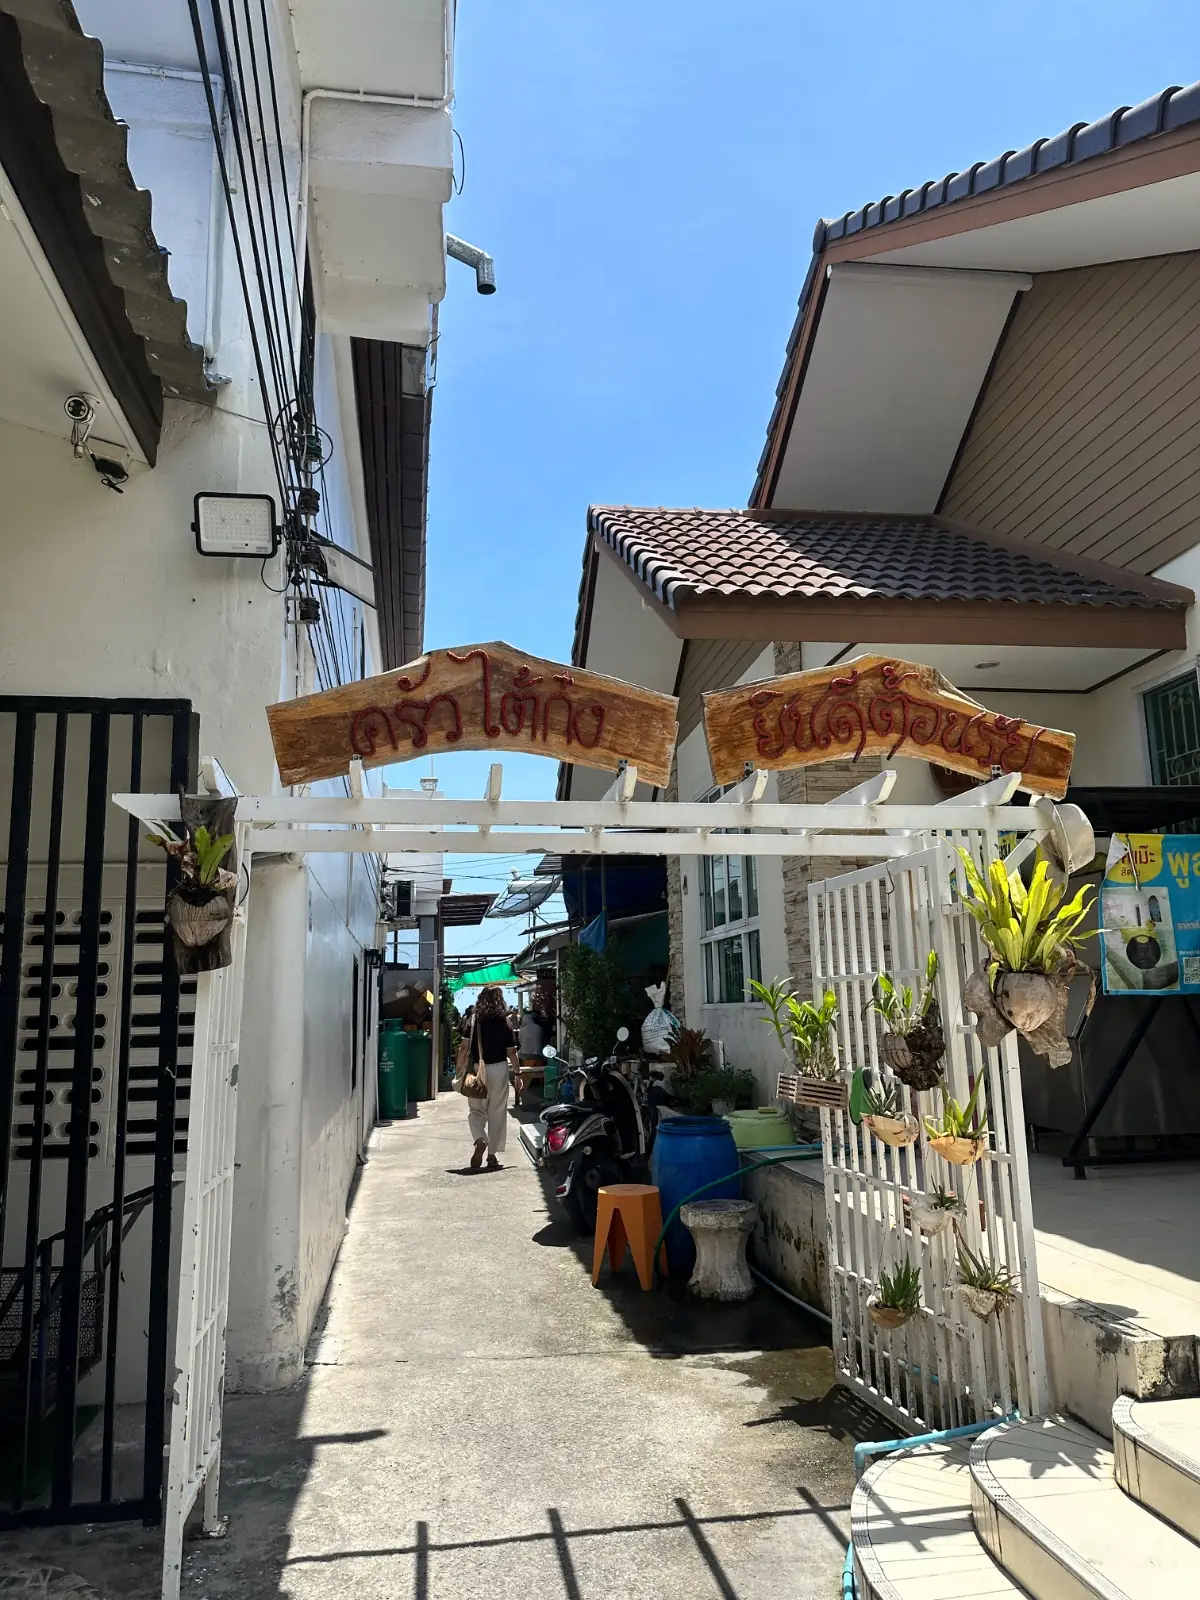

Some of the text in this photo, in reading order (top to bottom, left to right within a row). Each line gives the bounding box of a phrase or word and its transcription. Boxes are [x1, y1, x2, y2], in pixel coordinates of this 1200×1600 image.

[351, 649, 605, 756] ครัวไต้ก๋ง
[750, 665, 1047, 772] ยินดีต้อนรับ
